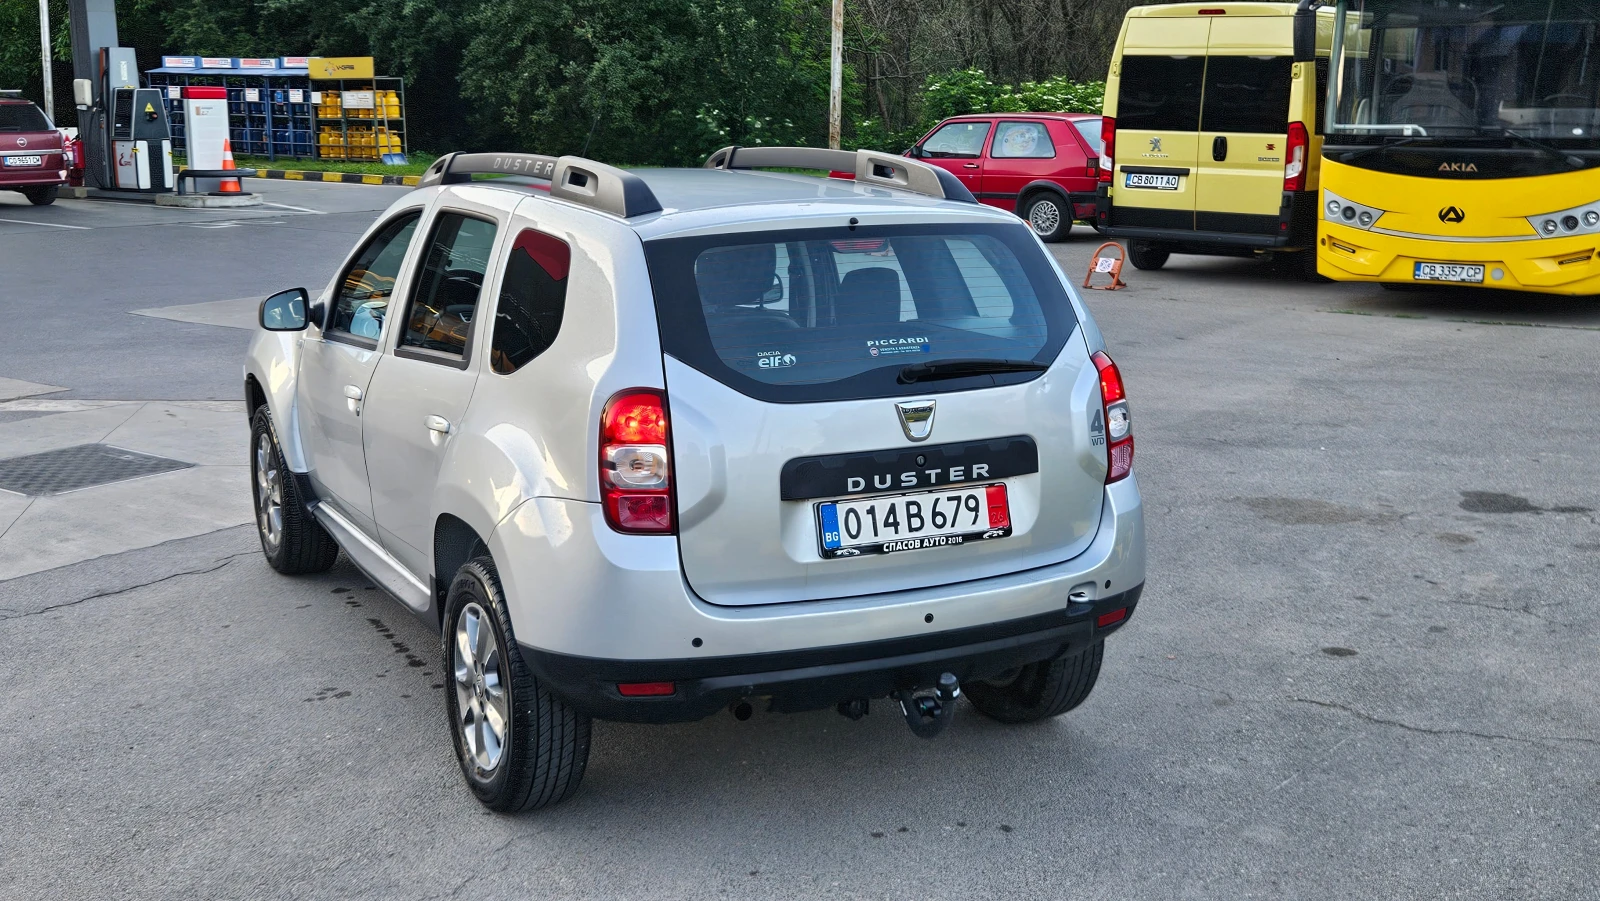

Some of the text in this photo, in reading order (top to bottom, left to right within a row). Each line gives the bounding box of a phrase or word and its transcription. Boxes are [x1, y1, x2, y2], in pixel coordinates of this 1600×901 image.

[493, 157, 554, 175] DUSTER
[1438, 162, 1478, 172] AKIA
[1438, 265, 1465, 277] 3357
[1466, 266, 1482, 278] CP
[866, 337, 929, 346] PICCARDI
[758, 356, 782, 368] elf
[1090, 408, 1104, 434] 4
[1091, 437, 1105, 446] WD
[847, 463, 990, 492] DUSTER
[825, 532, 839, 542] BG
[883, 536, 963, 552] СПАСОВ АУТО 2016
